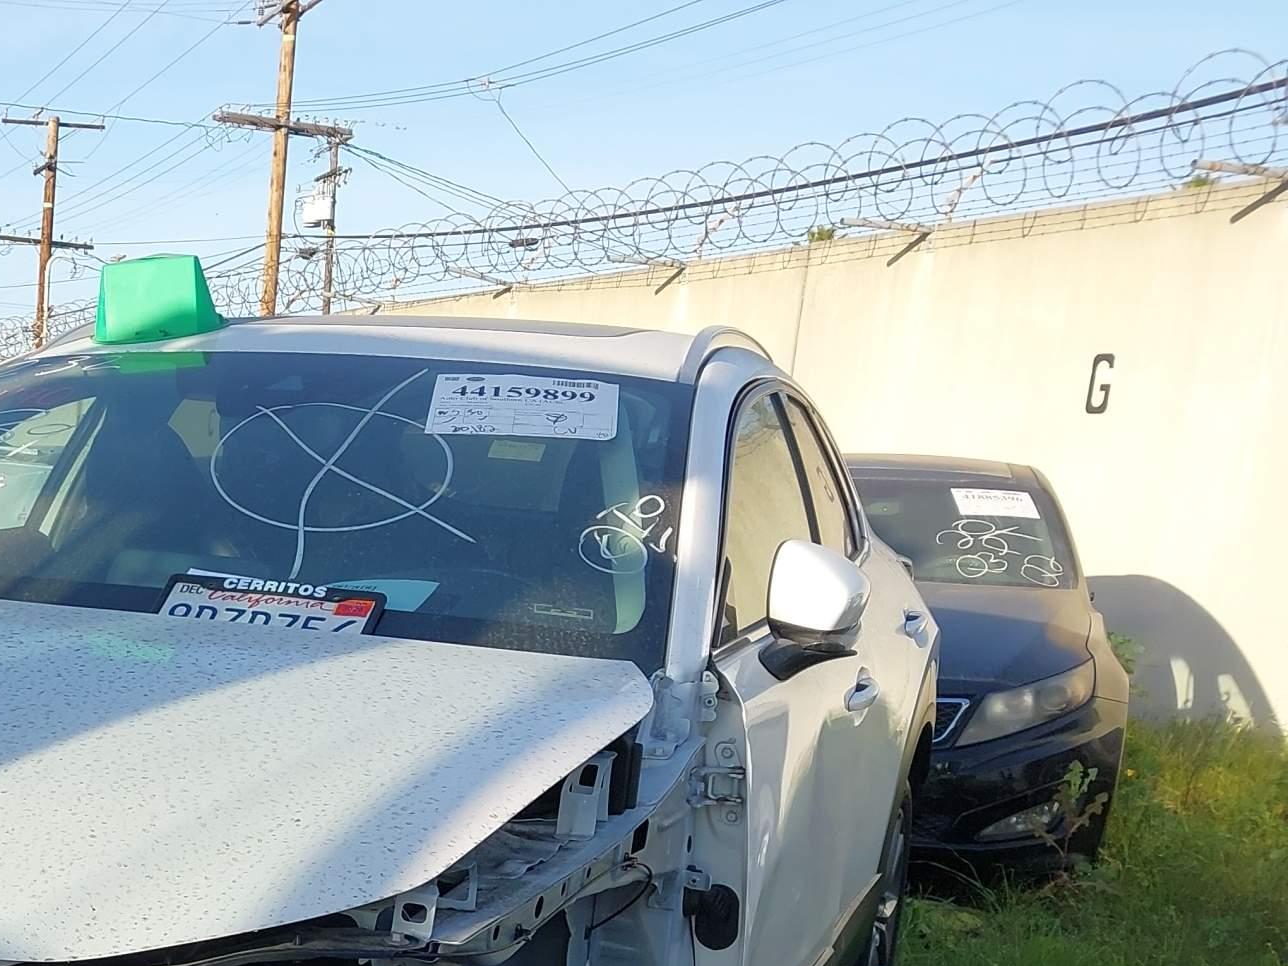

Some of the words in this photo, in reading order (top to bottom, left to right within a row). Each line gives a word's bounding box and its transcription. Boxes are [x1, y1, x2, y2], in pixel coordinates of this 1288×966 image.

[451, 384, 596, 403] 44159899
[1085, 353, 1115, 414] G
[179, 583, 205, 595] DEC
[223, 577, 328, 598] CERRITOS
[207, 588, 335, 612] California
